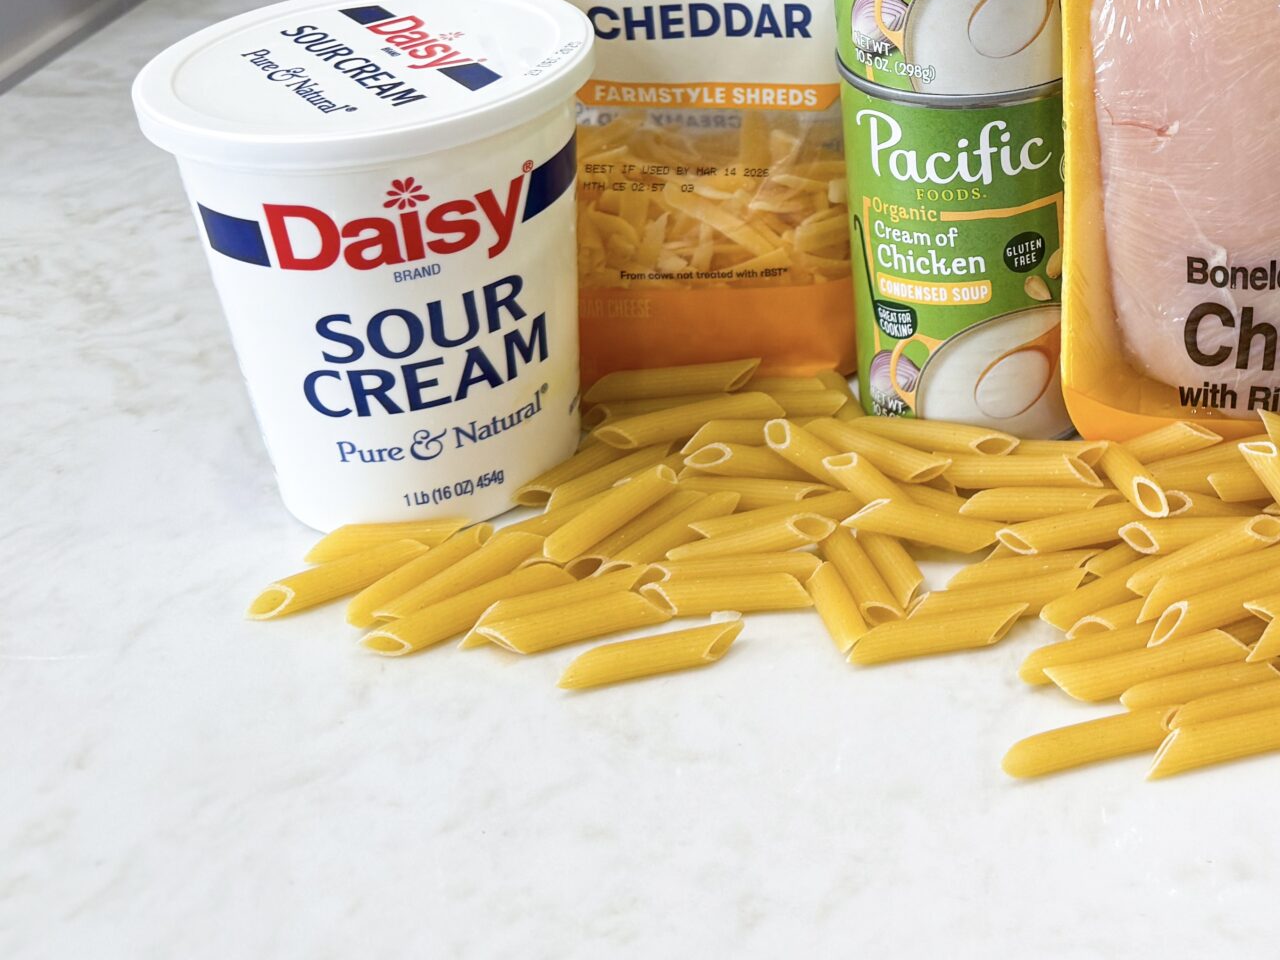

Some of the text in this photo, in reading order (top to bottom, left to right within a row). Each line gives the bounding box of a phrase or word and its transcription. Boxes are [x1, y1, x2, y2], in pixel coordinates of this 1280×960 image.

[587, 3, 812, 41] CHEDDAR
[366, 15, 474, 70] Daisy
[854, 31, 892, 56] NET WT.
[241, 48, 280, 72] Pure
[267, 67, 308, 83] &
[280, 25, 427, 107] SOUR CREAM
[855, 48, 936, 84] 10.5 OZ. (298g)
[594, 85, 818, 106] FARMSTYLE SHREDS
[855, 109, 1052, 185] Pacific
[585, 164, 769, 178] BEST IF USED BY MAR 14 2026
[916, 188, 981, 201] FOODS
[262, 173, 525, 272] Daisy
[872, 197, 937, 223] Organic
[874, 220, 958, 247] Cream of
[877, 243, 986, 276] Chicken
[1006, 238, 1042, 258] GLUTEN
[1014, 253, 1037, 268] FREE
[393, 263, 441, 283] BRAND
[620, 270, 646, 280] From
[648, 271, 674, 280] cows
[677, 271, 693, 280] not
[696, 270, 733, 279] treated
[736, 269, 757, 278] with
[880, 278, 988, 302] CONDENSED SOUP
[315, 274, 527, 364] SOUR
[878, 307, 912, 323] GREAT FOR
[880, 318, 913, 338] COOKING
[303, 311, 549, 418] CREAM
[1178, 381, 1239, 410] with
[337, 441, 405, 464] Pure
[410, 429, 447, 461] &
[404, 469, 505, 507] 1 Lb (16 OZ) 454g
